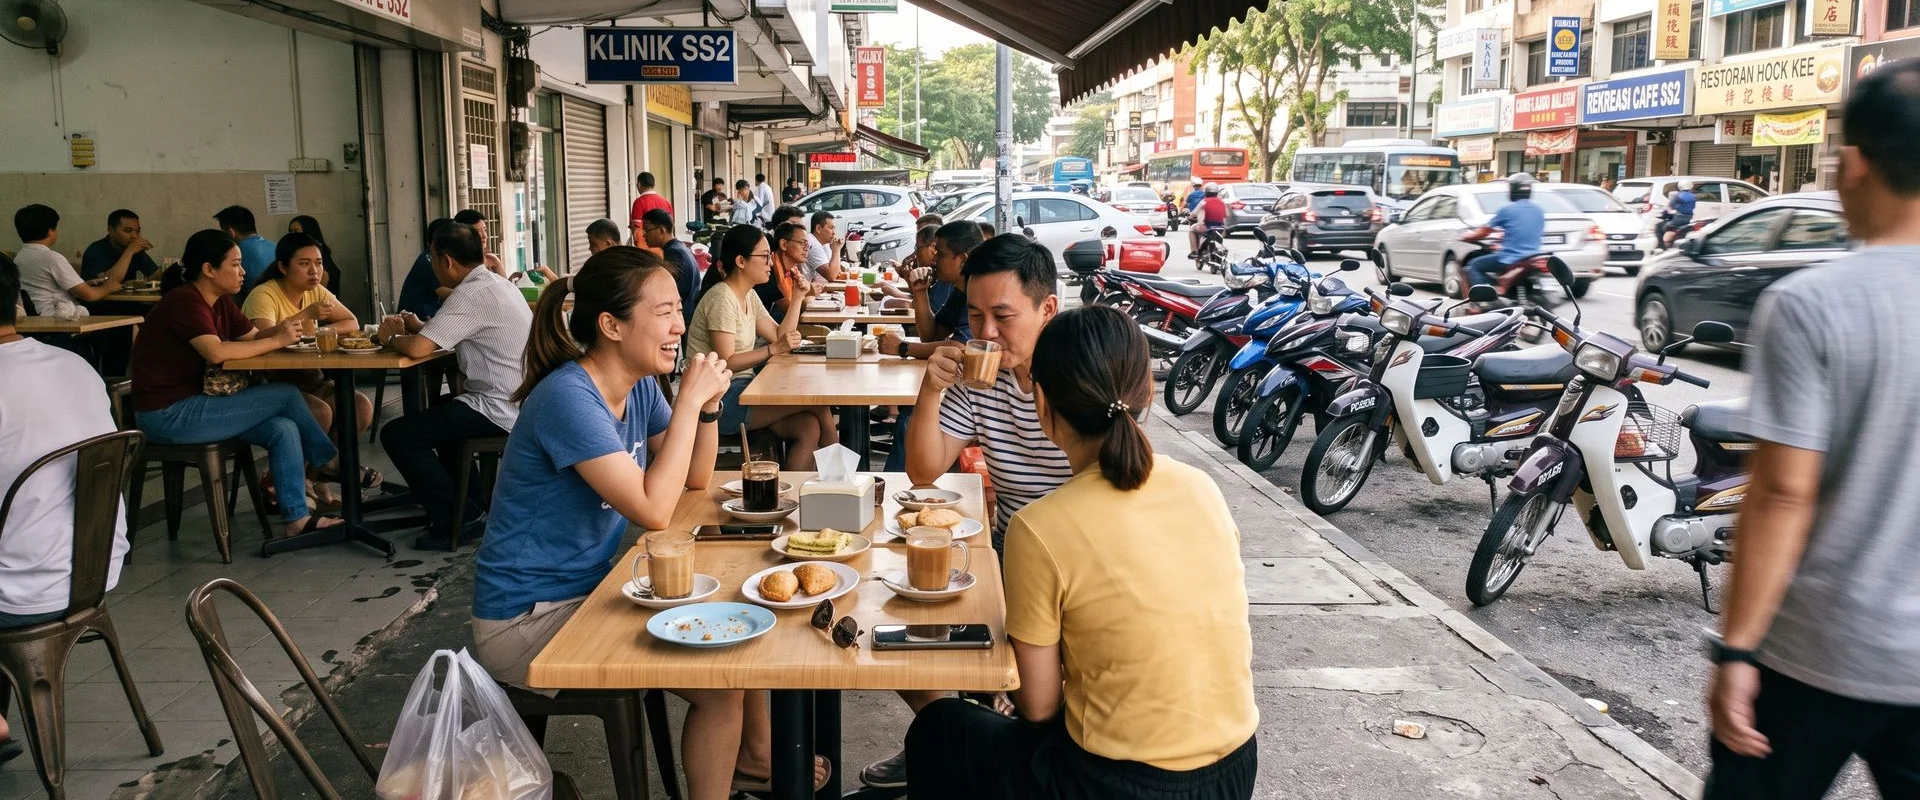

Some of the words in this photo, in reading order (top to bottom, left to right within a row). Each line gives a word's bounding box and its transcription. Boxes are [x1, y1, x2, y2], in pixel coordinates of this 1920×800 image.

[590, 34, 675, 61] KLINIK
[682, 34, 731, 62] SS2
[1700, 65, 1755, 89] RESTORAN
[1757, 60, 1788, 82] HOCK
[1791, 57, 1815, 79] KEE
[1587, 87, 1632, 115] REKREASI
[1633, 83, 1659, 110] CAFE
[1660, 80, 1681, 107] SS2
